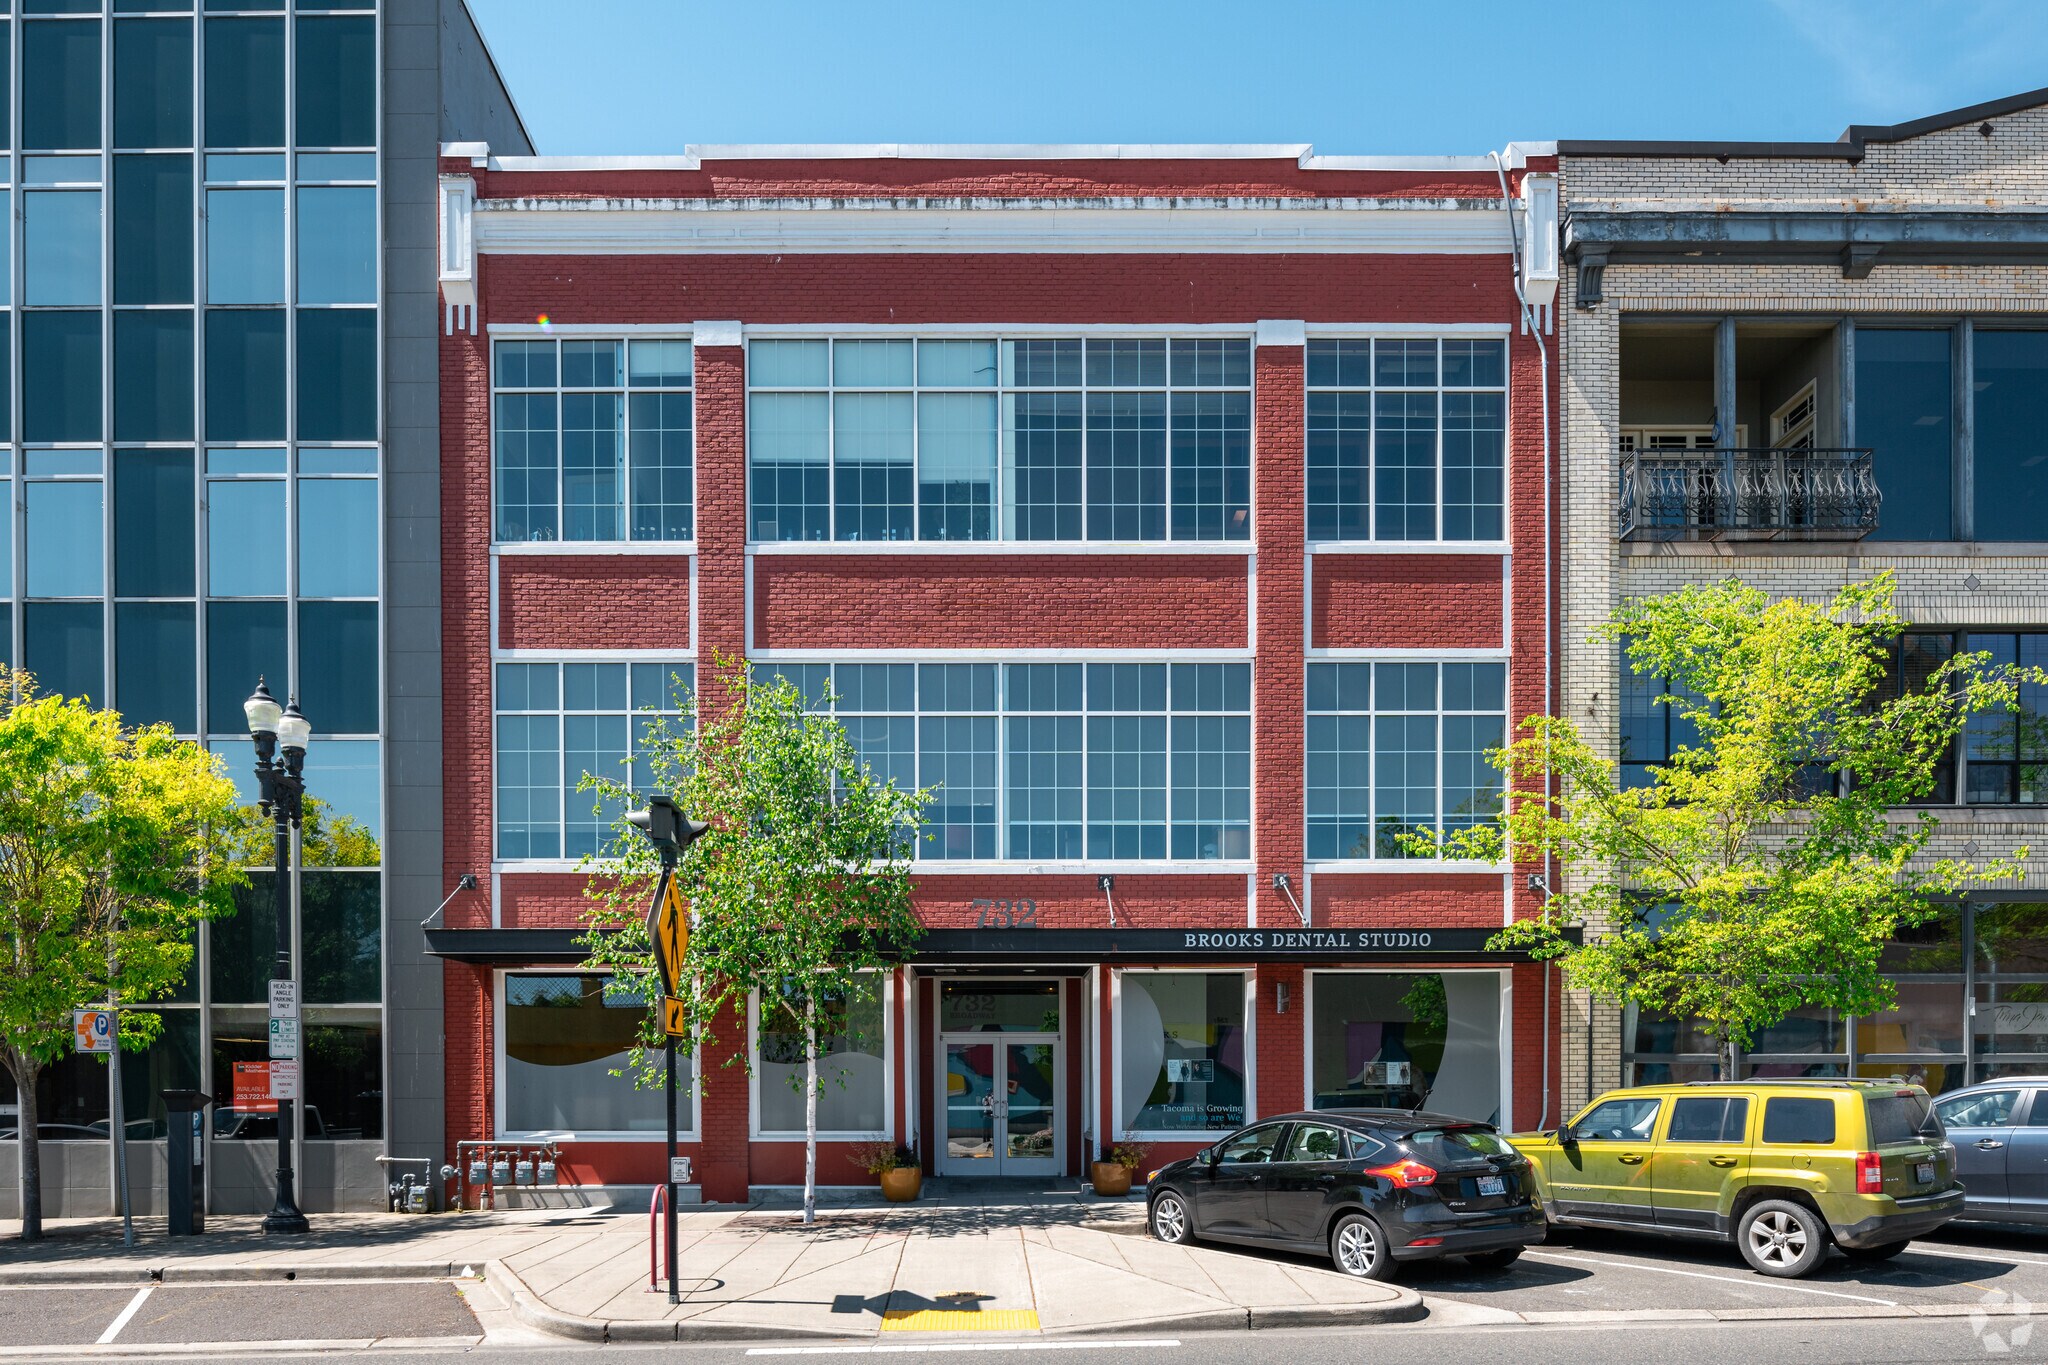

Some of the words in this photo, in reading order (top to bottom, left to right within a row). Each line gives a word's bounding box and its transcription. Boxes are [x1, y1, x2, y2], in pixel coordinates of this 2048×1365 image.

[971, 898, 1036, 929] 732
[1185, 933, 1264, 948] BROOKS
[1272, 933, 1350, 948] DENTAL
[1358, 933, 1431, 948] STUDIO
[951, 994, 996, 1012] 732
[98, 1017, 107, 1033] P
[271, 1021, 278, 1032] 2
[271, 1063, 279, 1071] NO
[1161, 1104, 1195, 1113] Tacoma
[1197, 1104, 1204, 1113] is
[1206, 1104, 1243, 1115] Growing
[1227, 1114, 1243, 1122] We.
